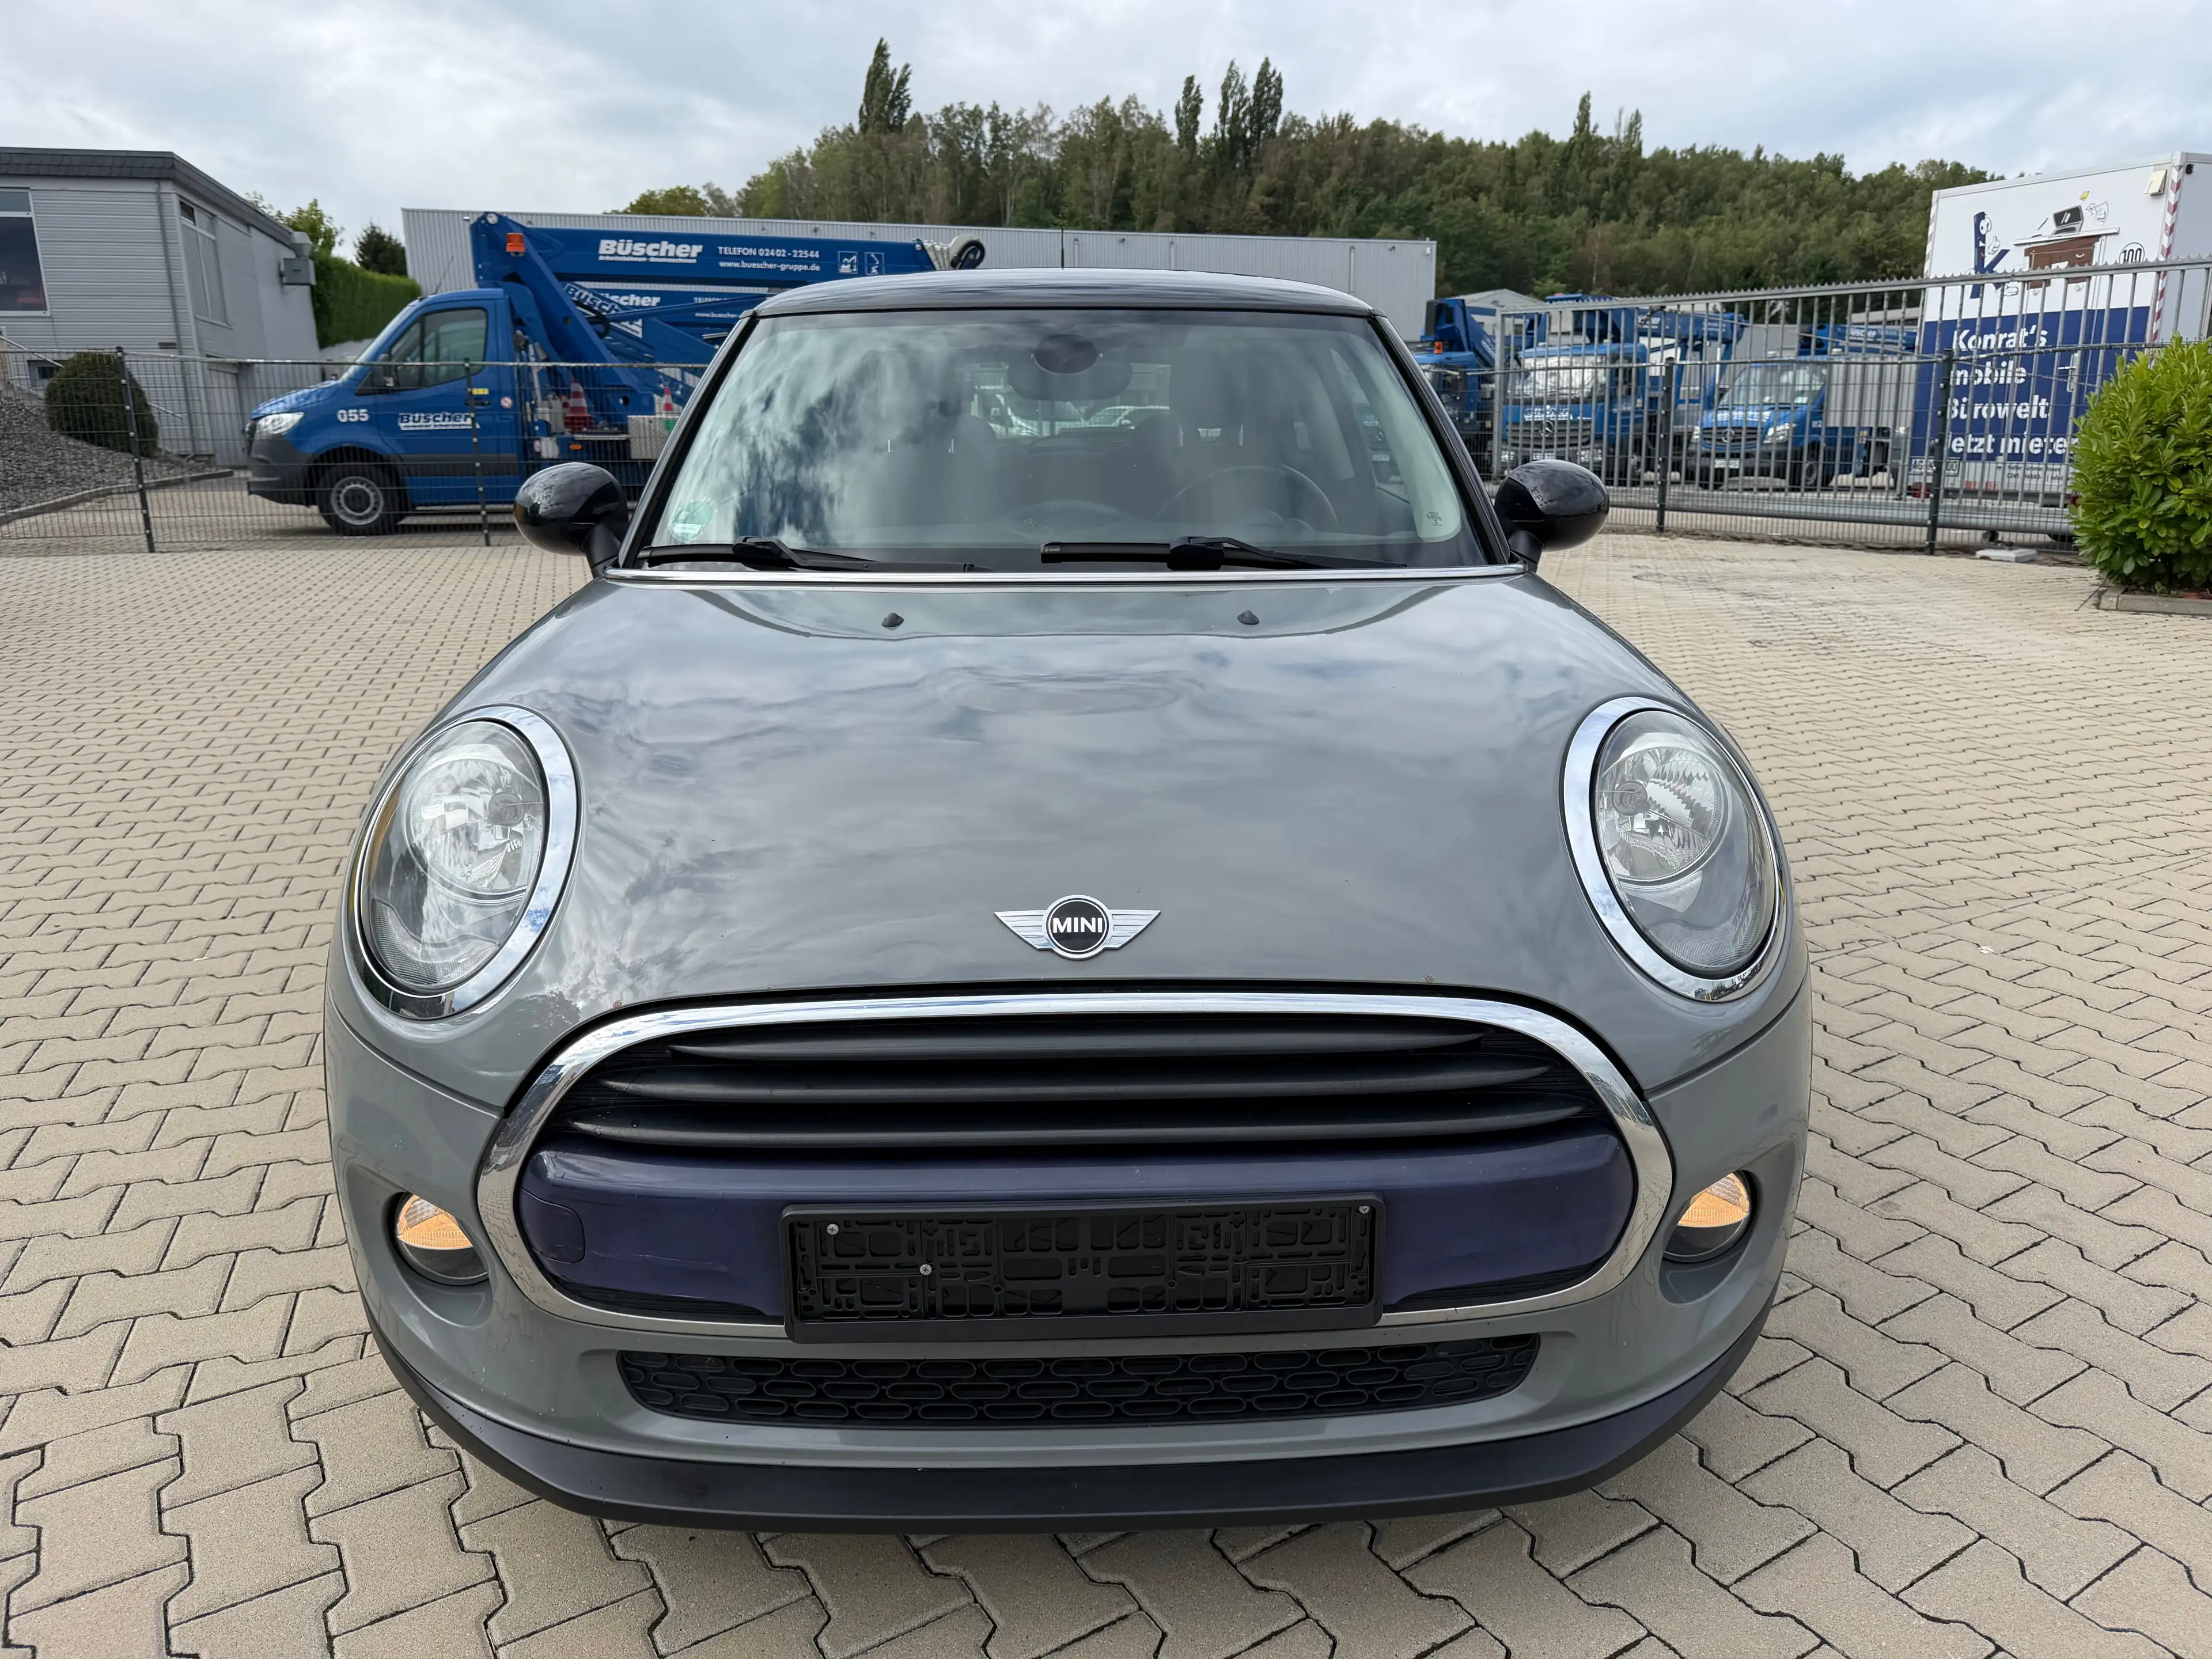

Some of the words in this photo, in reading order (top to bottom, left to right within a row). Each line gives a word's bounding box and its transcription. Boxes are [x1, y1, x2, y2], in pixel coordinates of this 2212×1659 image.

[598, 239, 703, 257] Büscher
[717, 246, 757, 256] TELEFON
[758, 248, 787, 257] 02402
[792, 249, 820, 258] 22544
[718, 260, 820, 272] www.buescher-gruppe.de
[1952, 325, 2048, 351] Konrat's
[1949, 360, 2027, 385] mobile
[337, 409, 369, 422] 055
[399, 411, 476, 423] Büscher
[1053, 917, 1103, 933] MINI
